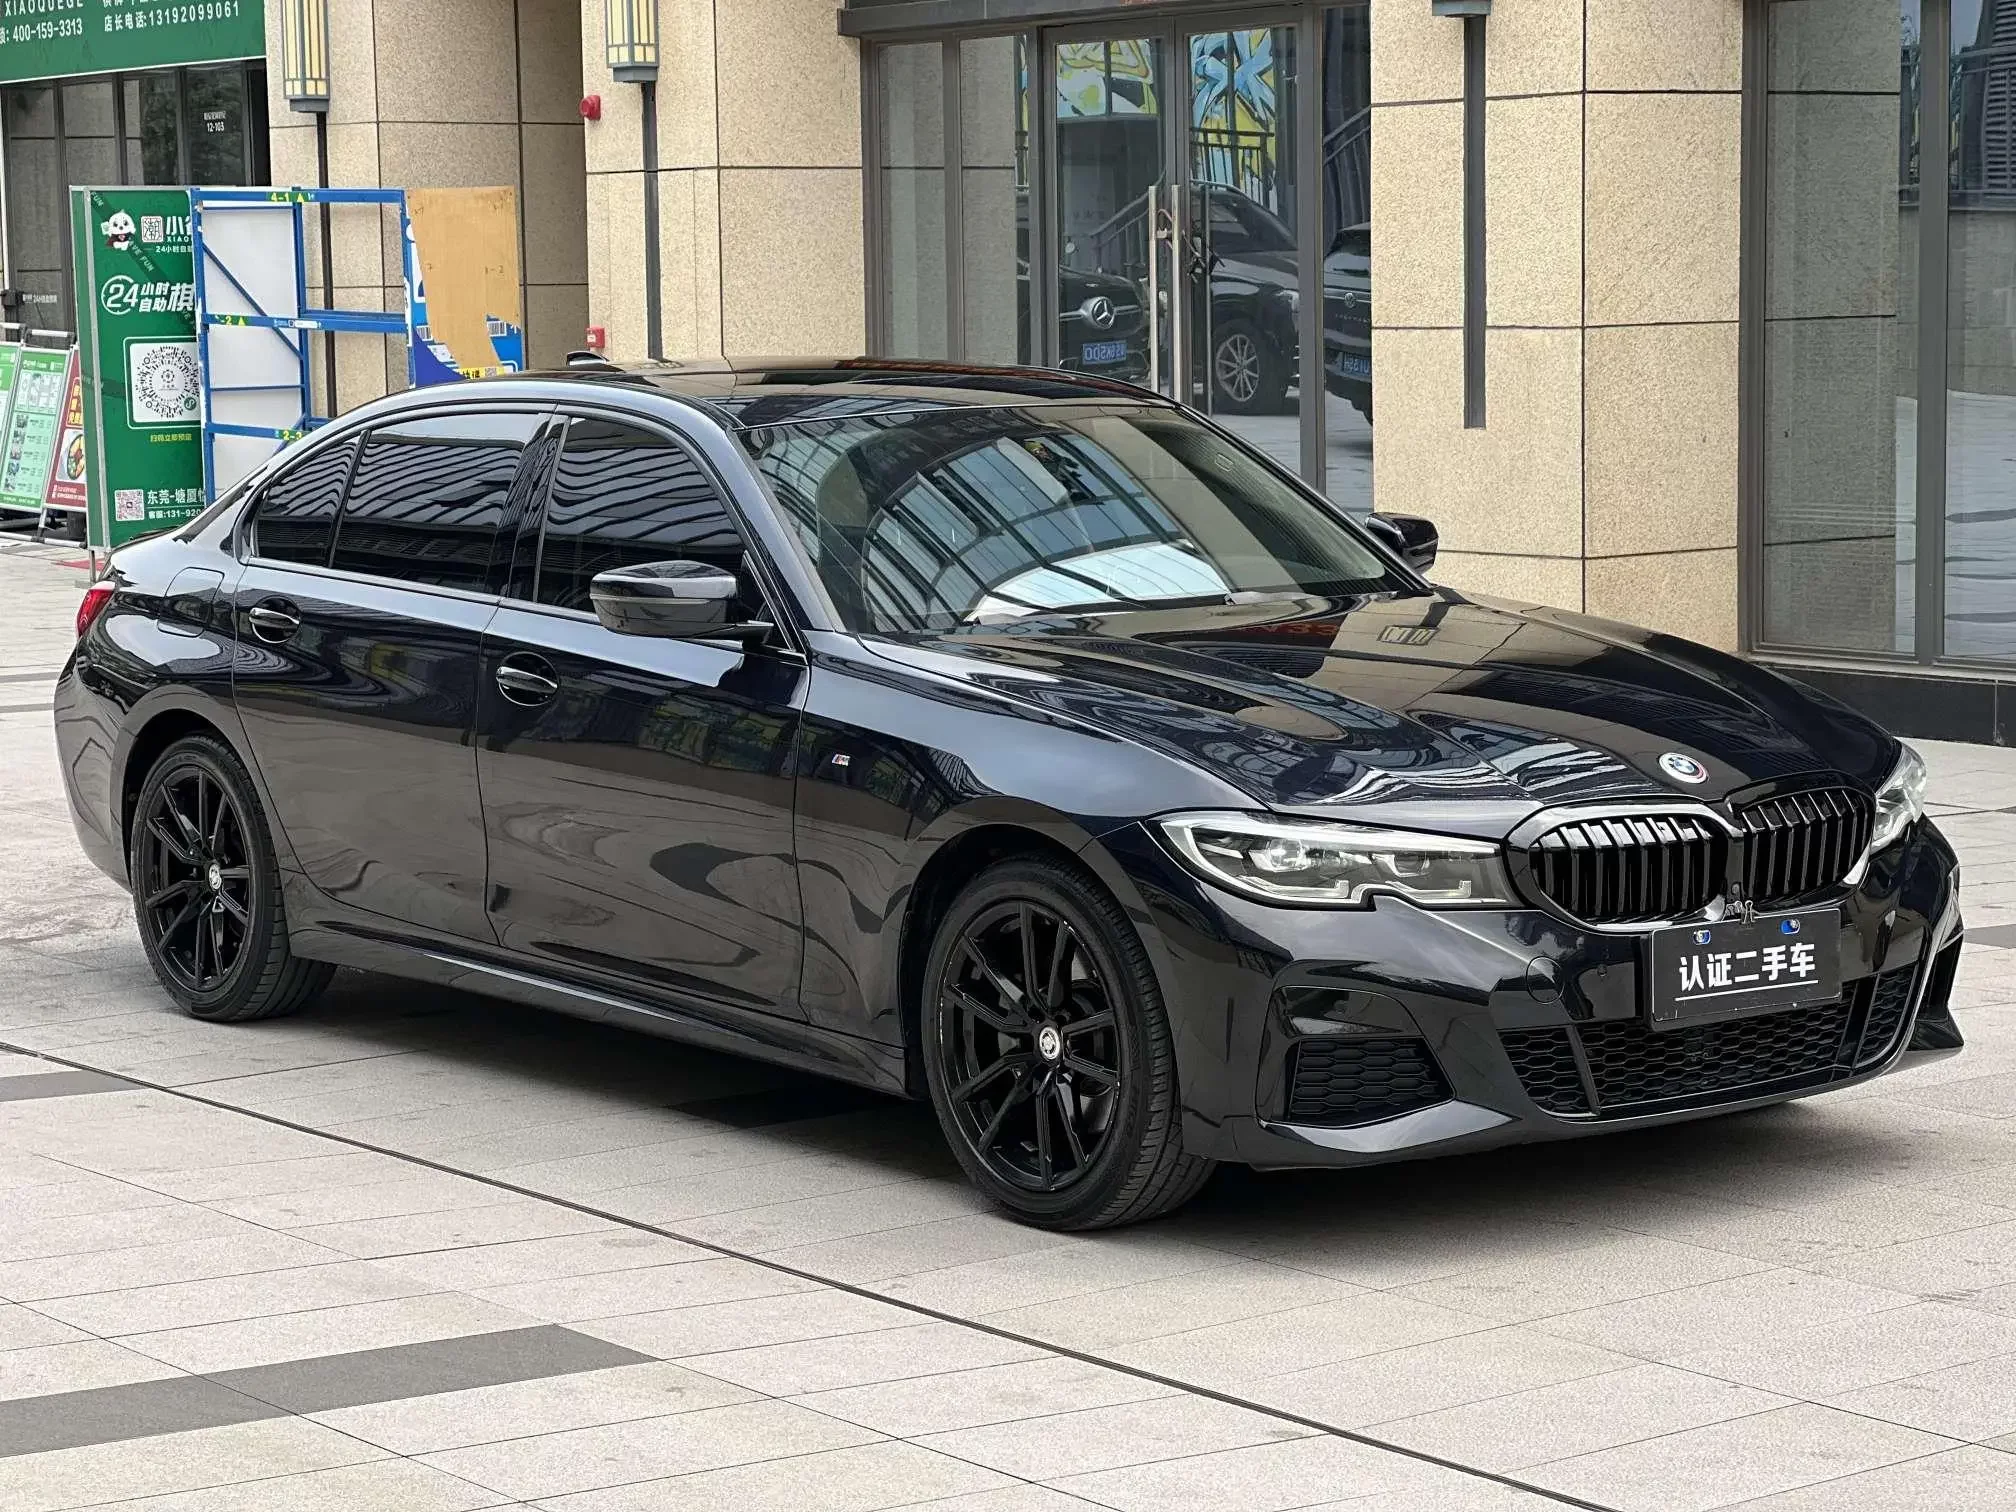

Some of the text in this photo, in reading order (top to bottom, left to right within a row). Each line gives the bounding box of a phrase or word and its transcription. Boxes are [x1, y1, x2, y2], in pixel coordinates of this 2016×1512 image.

[104, 0, 239, 32] 店长电话:13192099061
[1679, 942, 1816, 992] 认证二手车
